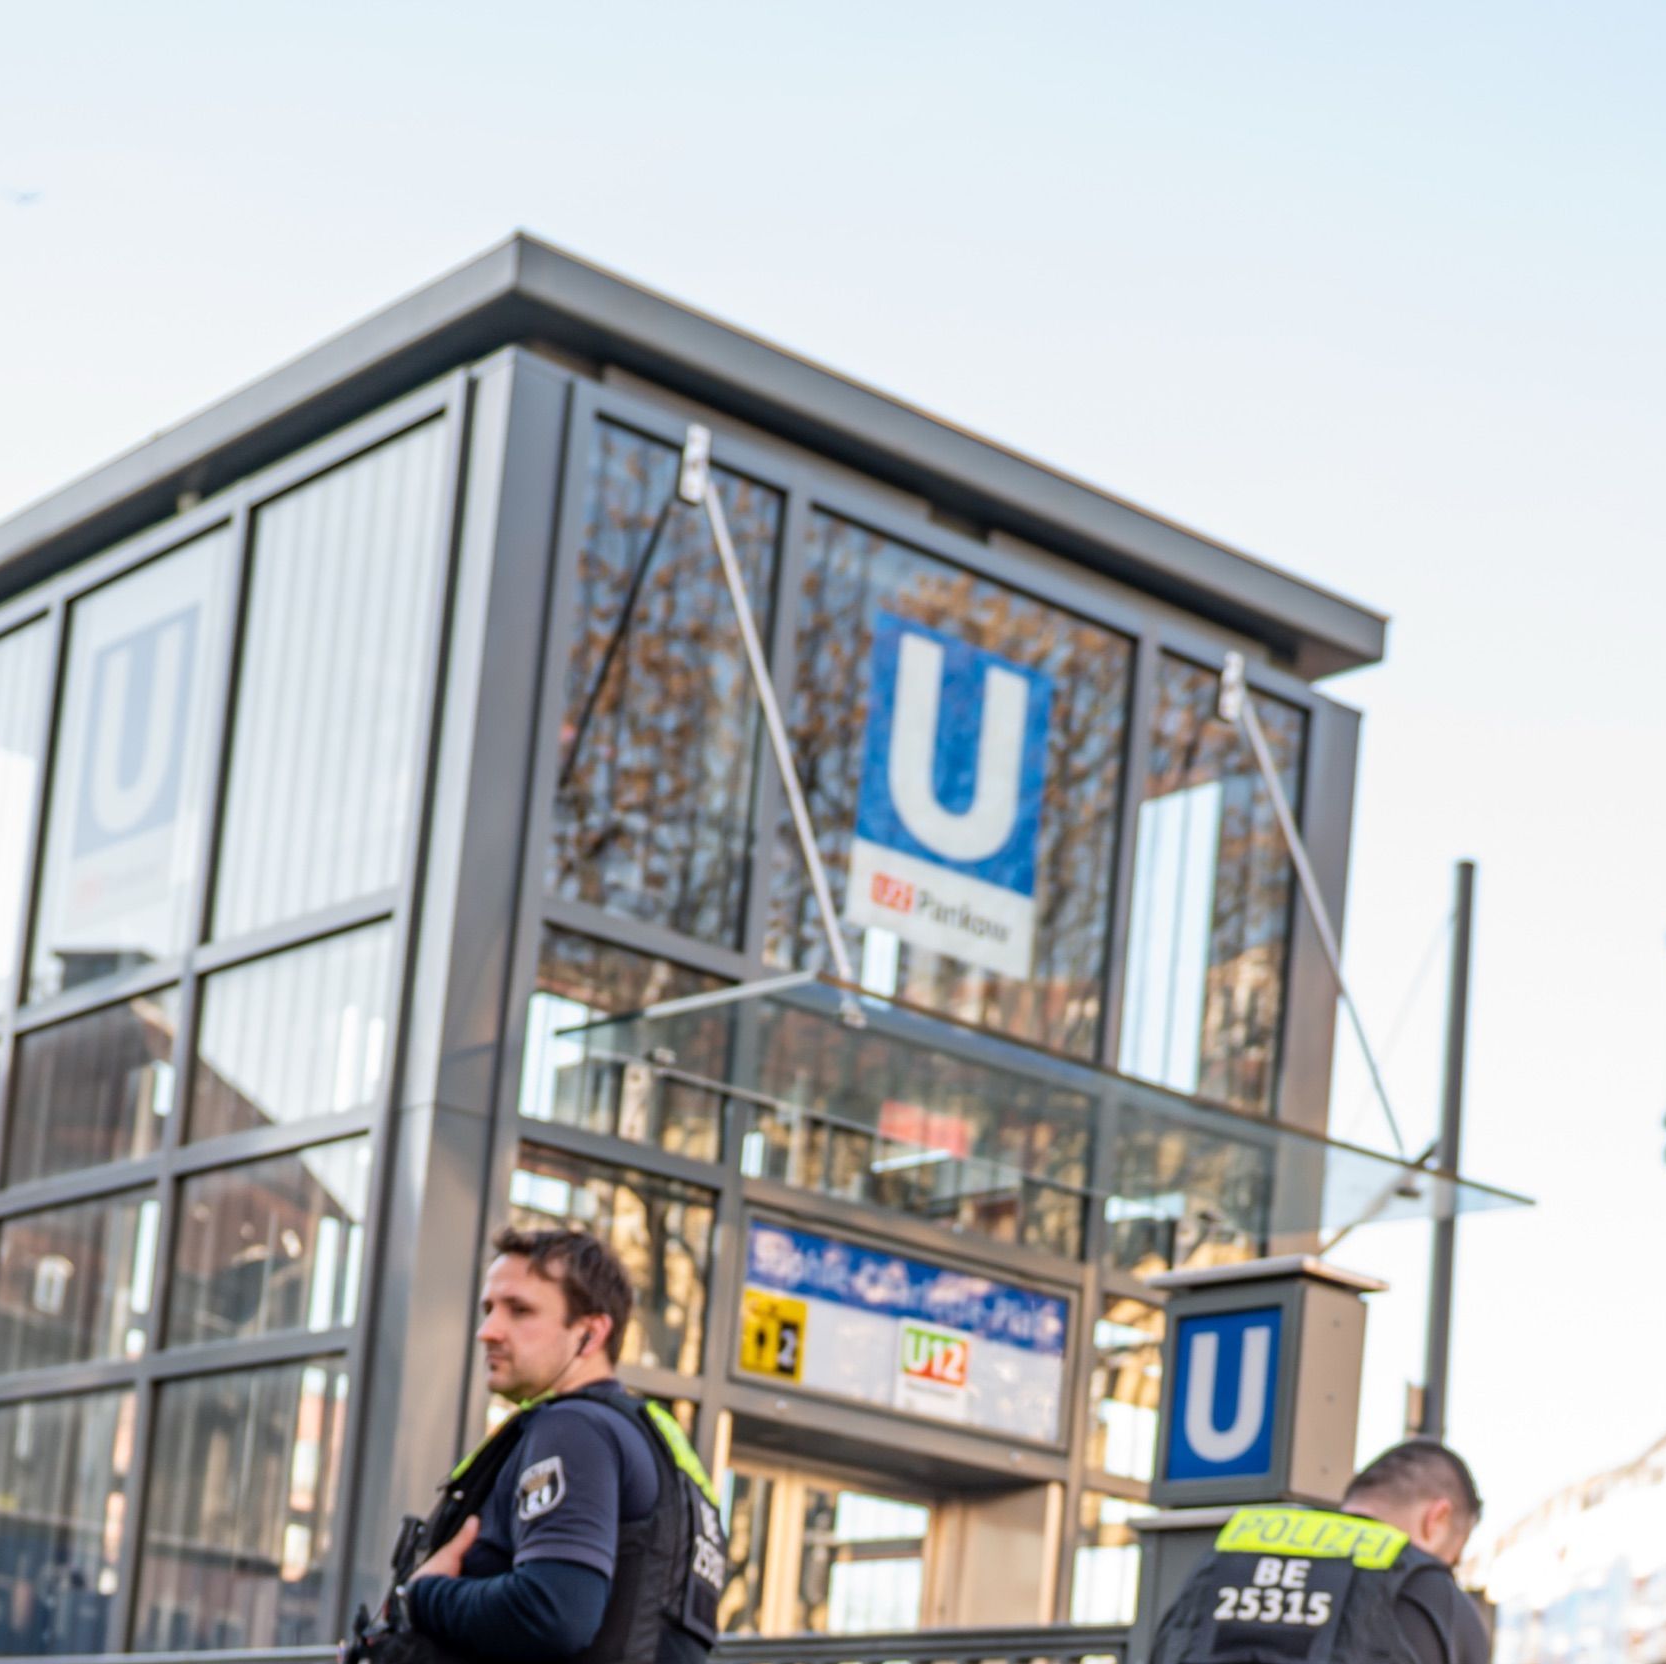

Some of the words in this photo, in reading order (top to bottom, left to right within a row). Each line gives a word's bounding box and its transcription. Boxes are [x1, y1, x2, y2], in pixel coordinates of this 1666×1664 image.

[888, 633, 1029, 862] U
[778, 1327, 796, 1368] 2
[905, 1332, 963, 1383] U12
[1184, 1325, 1271, 1463] U
[1230, 1515, 1393, 1559] POLIZEI
[1252, 1556, 1312, 1589] BE
[1213, 1586, 1332, 1626] 25315
